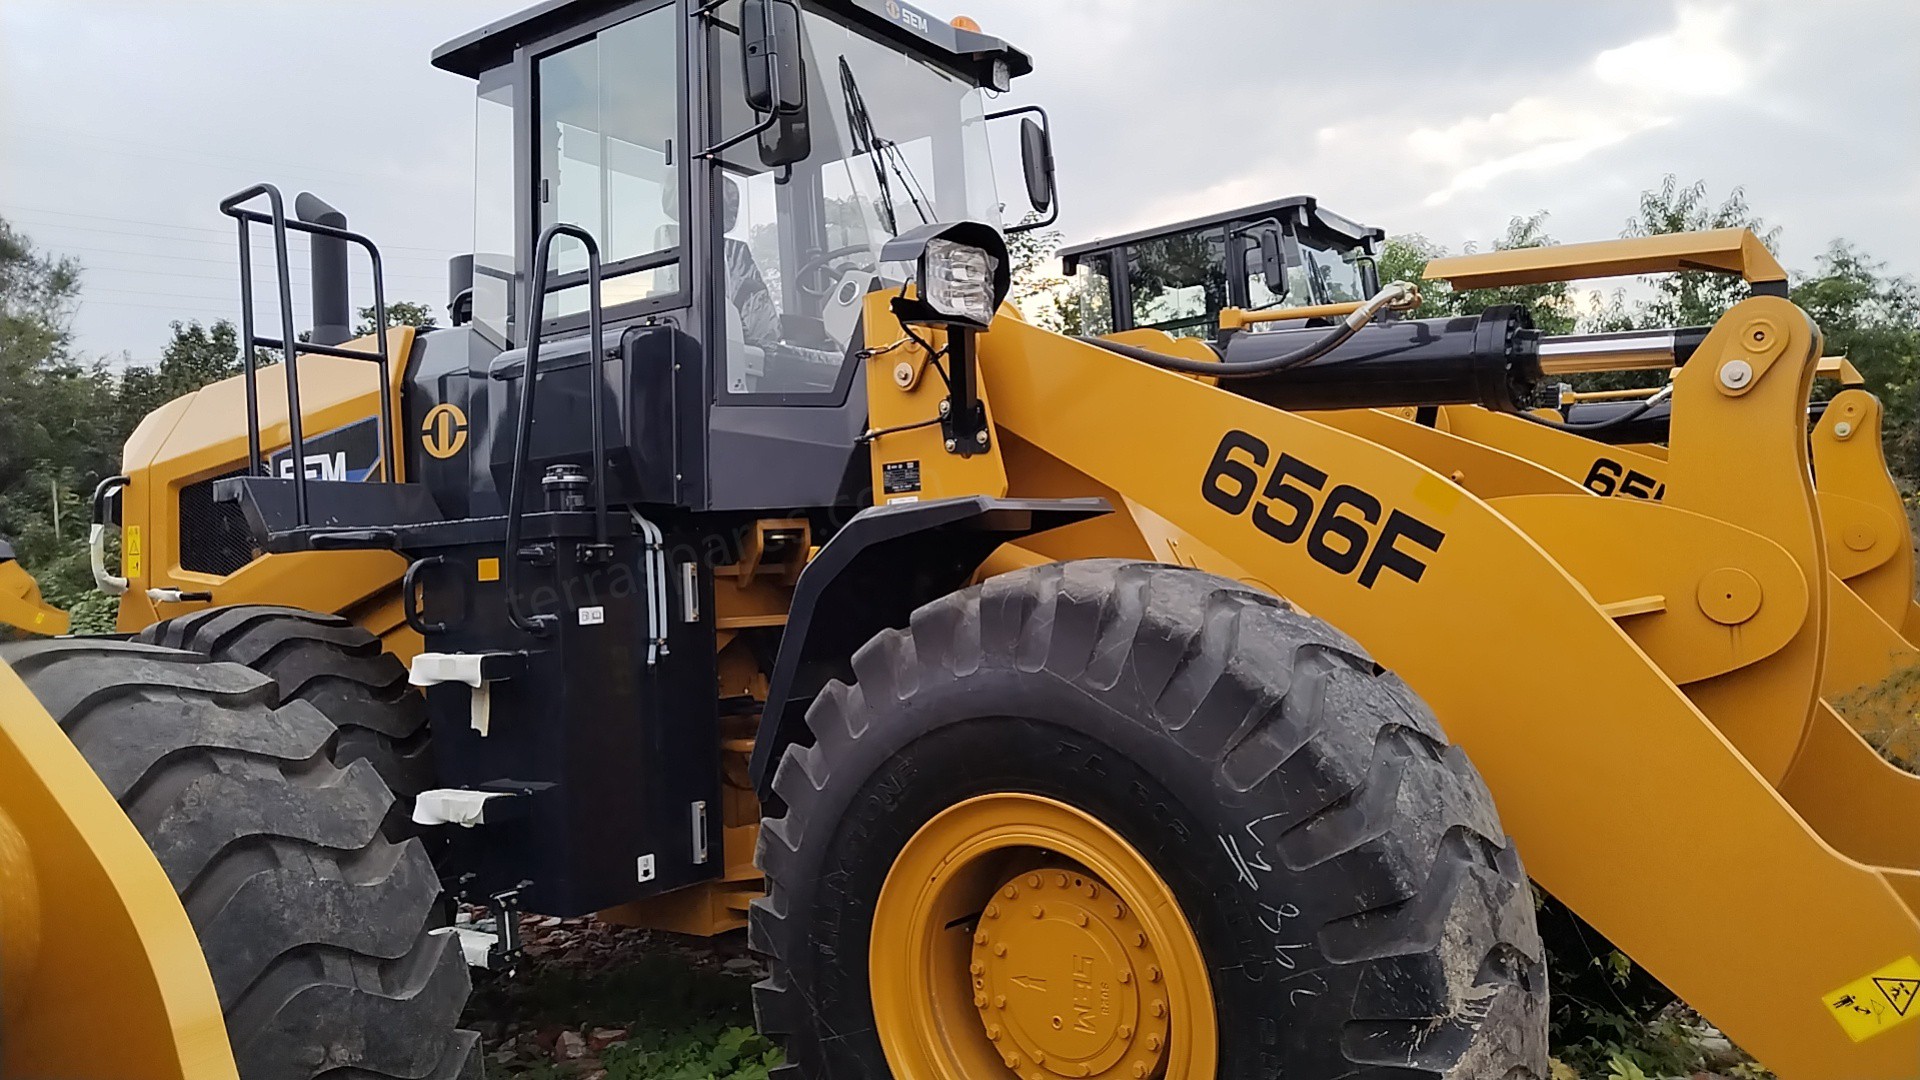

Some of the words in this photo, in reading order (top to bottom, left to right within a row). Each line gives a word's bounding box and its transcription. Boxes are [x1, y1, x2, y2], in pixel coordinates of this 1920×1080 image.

[902, 7, 929, 34] SEM
[1201, 429, 1446, 590] 656F
[1583, 457, 1666, 501] 65
[1071, 953, 1097, 1036] SEM
